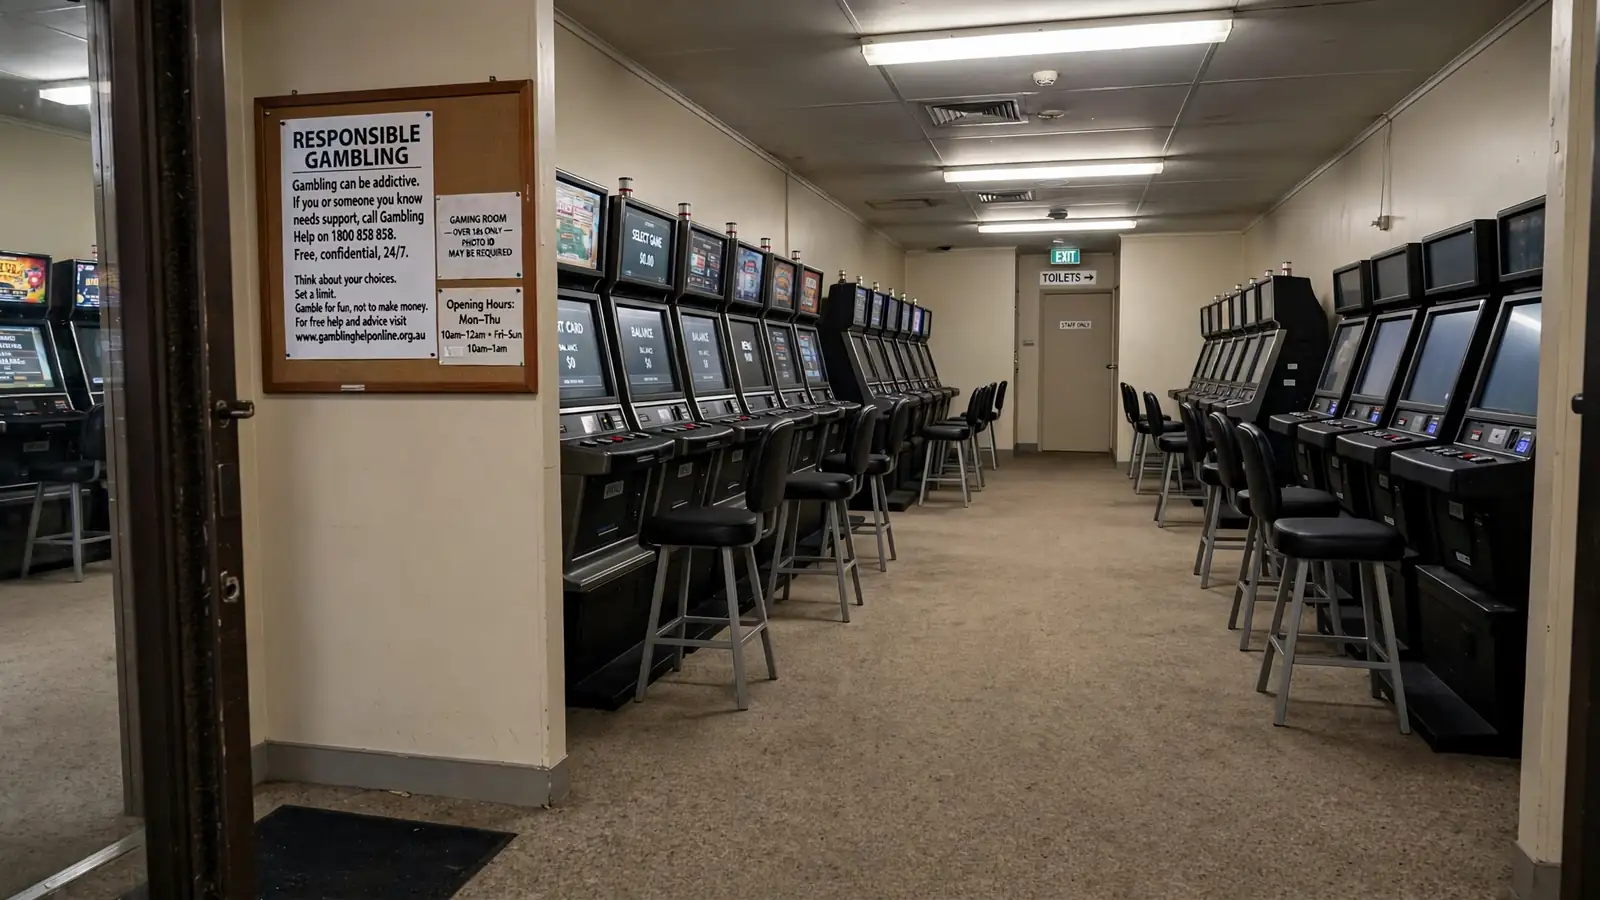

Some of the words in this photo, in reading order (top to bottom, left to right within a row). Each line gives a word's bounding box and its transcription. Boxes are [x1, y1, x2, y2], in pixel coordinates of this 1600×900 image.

[293, 124, 420, 149] RESPONSIBLE
[305, 146, 409, 169] GAMBLING
[292, 178, 337, 193] Gambling
[339, 178, 357, 190] can
[358, 175, 371, 189] be
[372, 174, 420, 188] addictive.
[293, 196, 301, 208] If
[302, 198, 319, 211] you
[321, 198, 332, 207] or
[333, 196, 375, 207] someone
[376, 195, 394, 209] you
[396, 192, 423, 205] know
[293, 212, 320, 225] needs
[322, 211, 360, 227] support,
[362, 210, 378, 223] call
[380, 209, 424, 225] Gambling
[449, 215, 481, 224] GAMING
[482, 214, 507, 223] ROOM
[294, 229, 315, 244] Help
[317, 231, 329, 242] on
[331, 229, 355, 241] 1800
[356, 229, 374, 241] 858
[376, 228, 397, 240] 858.
[453, 228, 471, 236] OVER
[484, 227, 503, 235] ONLY
[632, 229, 650, 244] SELECT
[461, 238, 486, 247] PHOTO
[294, 248, 318, 263] Free,
[320, 246, 381, 261] confidential,
[383, 246, 409, 260] 24/7.
[448, 249, 465, 258] MAY
[466, 249, 476, 257] BE
[476, 248, 513, 258] REQUIRED
[1056, 251, 1076, 262] EXIT
[294, 274, 317, 285] Think
[318, 273, 342, 285] about
[344, 274, 362, 287] your
[364, 273, 397, 284] choices.
[1042, 273, 1081, 283] TOILETS
[294, 289, 308, 299] Set
[309, 291, 315, 299] a
[316, 288, 337, 299] limit.
[295, 303, 323, 313] Gamble
[324, 303, 335, 313] for
[337, 302, 352, 314] fun,
[353, 303, 367, 312] not
[368, 303, 377, 312] to
[378, 302, 398, 312] make
[400, 303, 428, 314] money.
[446, 299, 483, 311] Opening
[486, 299, 515, 309] Hours:
[295, 318, 308, 327] For
[309, 317, 325, 327] free
[326, 316, 344, 329] help
[345, 315, 361, 326] and
[362, 315, 388, 326] advice
[389, 315, 407, 326] visit
[566, 321, 584, 334] CARD
[295, 330, 426, 344] www.gamblinghelponline.org.au
[566, 356, 577, 370] $0
